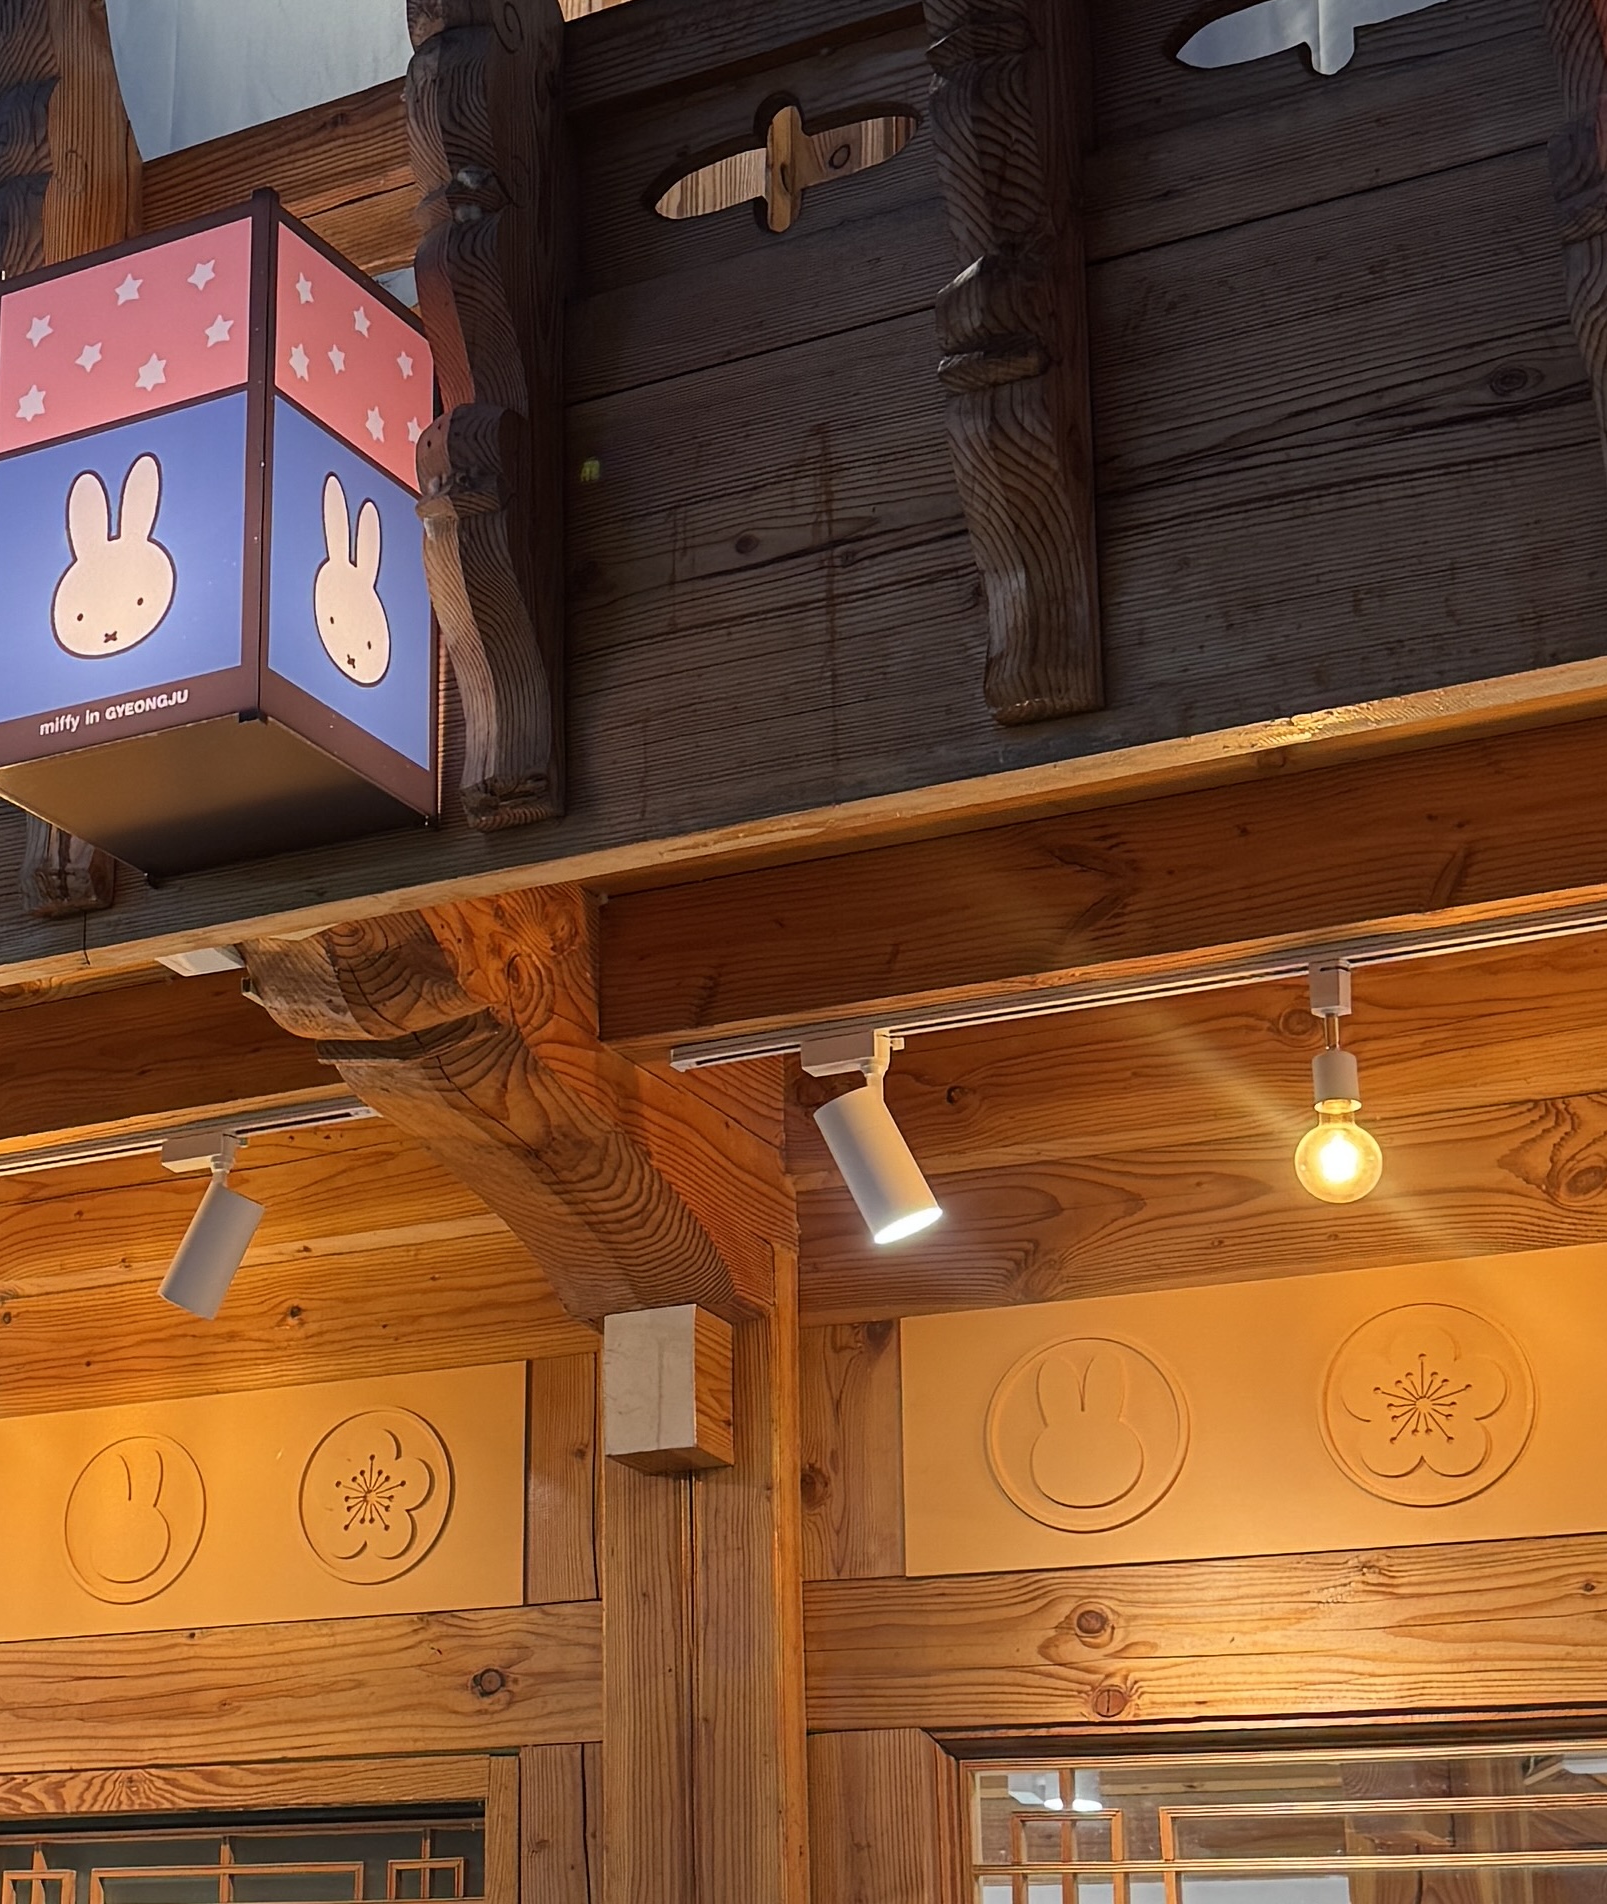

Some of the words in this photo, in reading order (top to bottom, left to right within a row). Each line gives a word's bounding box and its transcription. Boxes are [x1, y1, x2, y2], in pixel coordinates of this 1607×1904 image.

[39, 714, 81, 736] miffy
[85, 709, 100, 725] in
[105, 689, 189, 721] GYEONGJU
